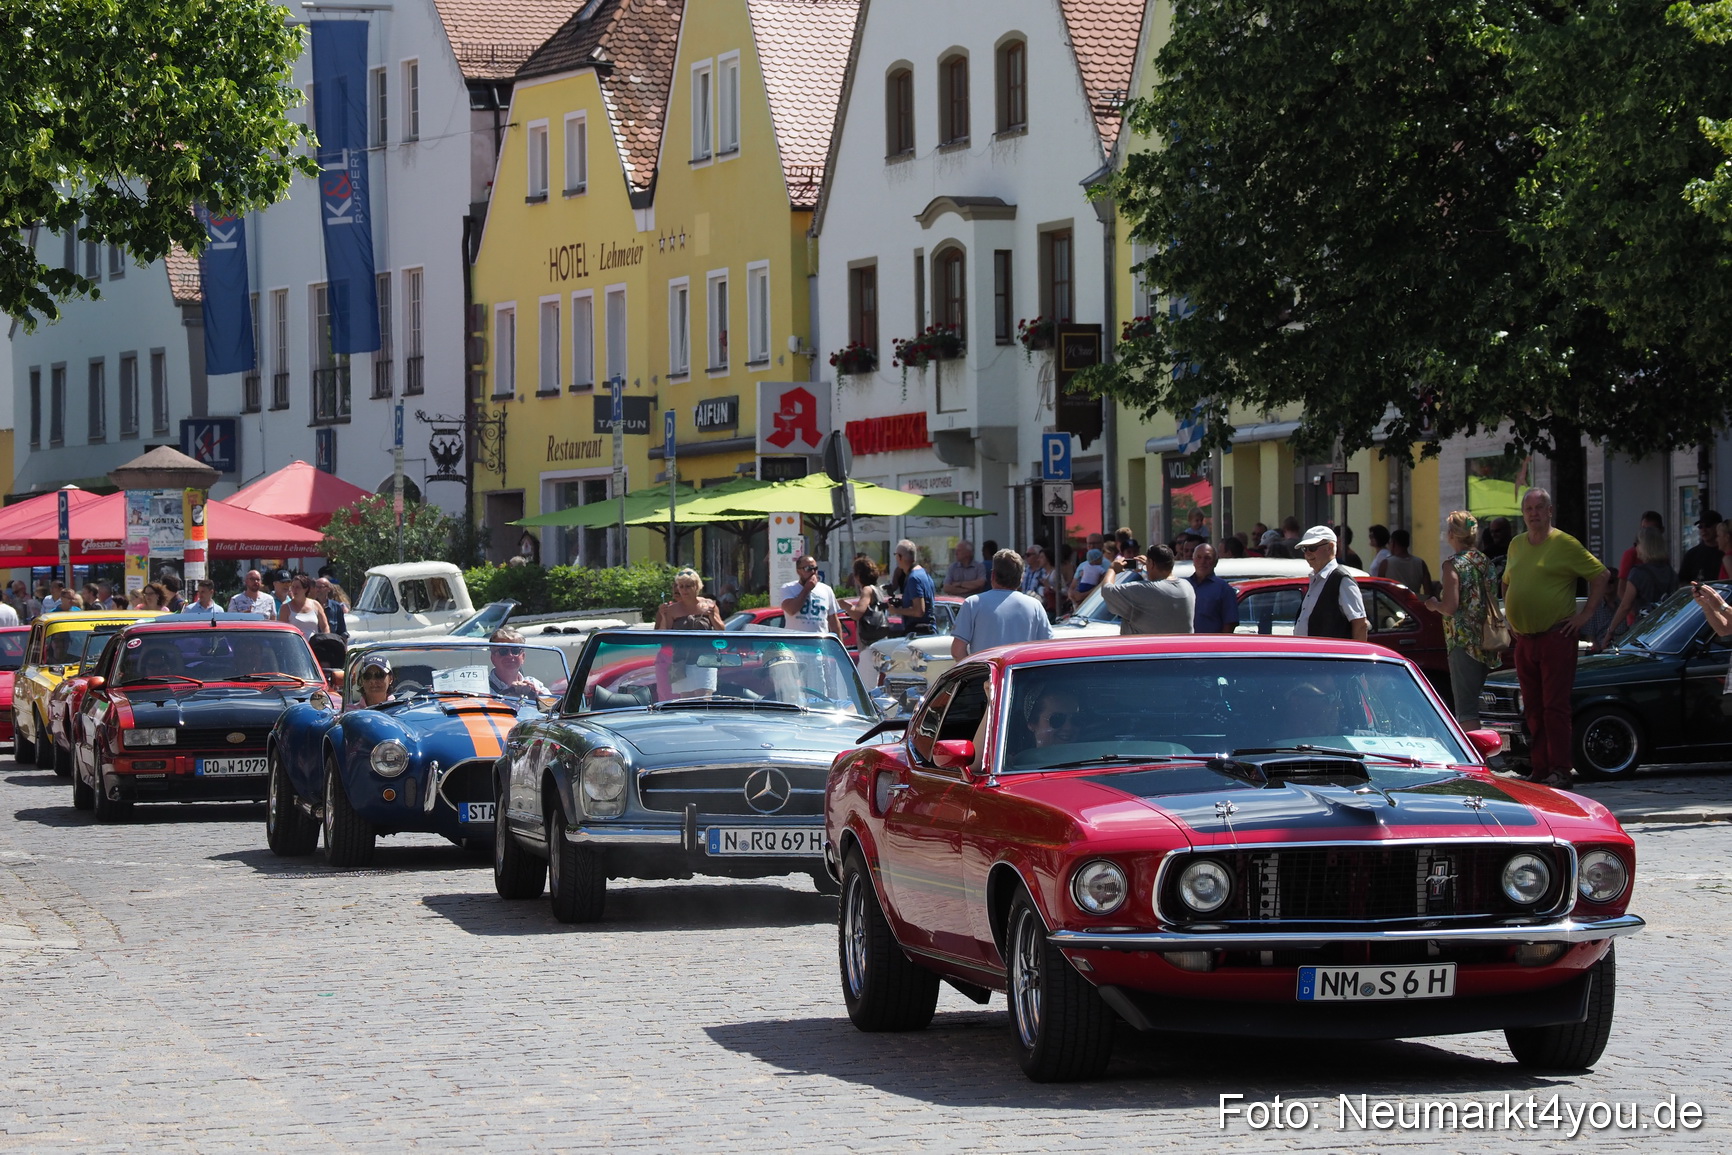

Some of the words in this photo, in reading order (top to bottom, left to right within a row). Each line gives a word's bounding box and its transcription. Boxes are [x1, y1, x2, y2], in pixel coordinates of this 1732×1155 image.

[549, 242, 589, 282] HOTEL
[599, 238, 644, 271] Lehmeier
[598, 419, 647, 429] TAFUN
[692, 402, 729, 427] TAIFUN
[667, 418, 673, 452] P
[546, 435, 603, 462] Restaurant
[1049, 439, 1064, 474] P
[216, 542, 237, 551] Hotel
[239, 543, 282, 552] Restaurant
[460, 671, 478, 679] 475
[1394, 741, 1425, 749] 145
[204, 760, 219, 774] CO
[228, 760, 235, 773] W
[238, 759, 267, 772] 1979
[725, 832, 737, 850] N
[751, 832, 776, 850] RQ
[781, 832, 804, 850] 69
[810, 832, 822, 850] H
[1321, 971, 1359, 996] NM
